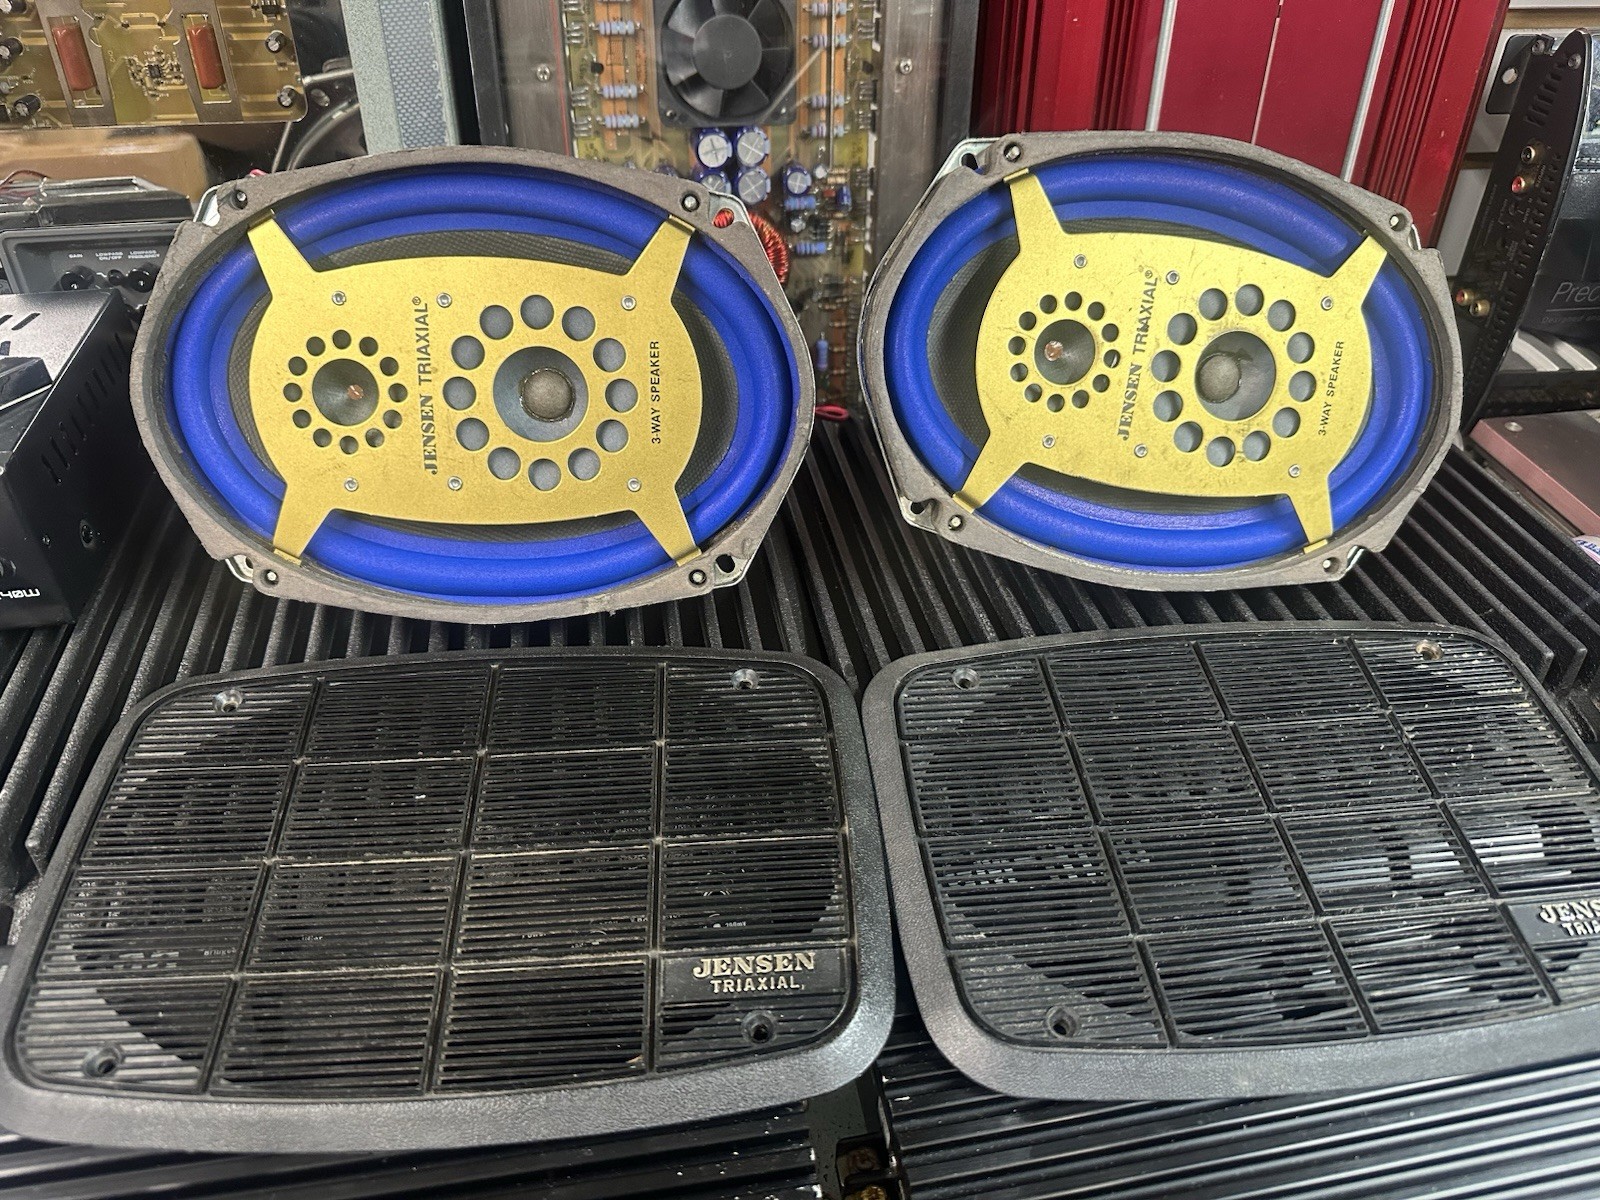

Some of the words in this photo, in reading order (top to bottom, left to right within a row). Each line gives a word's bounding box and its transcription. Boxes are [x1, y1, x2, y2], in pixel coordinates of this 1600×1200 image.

[648, 340, 662, 403] SPEAKER
[1116, 362, 1144, 442] JENSEN
[1317, 401, 1334, 437] 3-WAY
[1326, 340, 1345, 399] SPEAKER
[418, 393, 438, 476] JENSEN
[650, 405, 663, 445] 3-WAY
[692, 951, 816, 979] JENSEN
